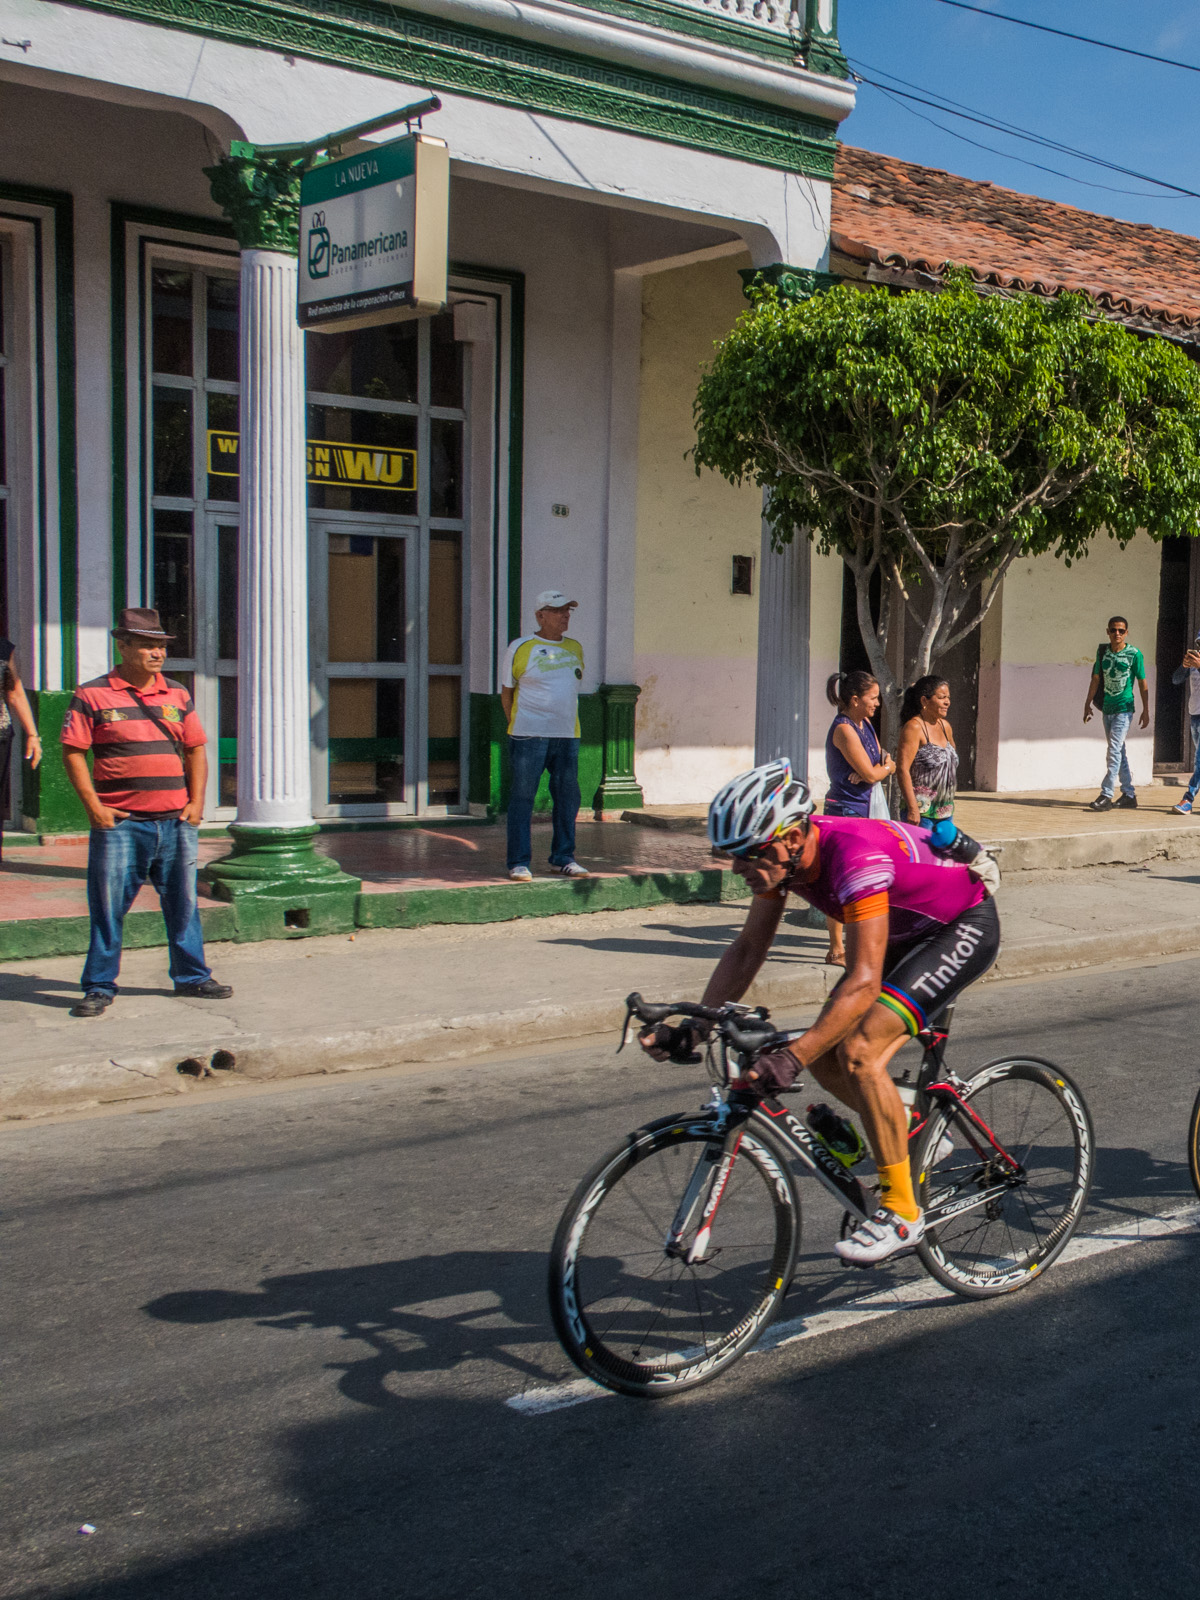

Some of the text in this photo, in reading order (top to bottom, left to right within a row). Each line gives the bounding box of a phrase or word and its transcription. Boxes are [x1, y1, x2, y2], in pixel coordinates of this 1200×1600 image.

[335, 160, 379, 187] LA NUEVA
[331, 230, 408, 265] Panamericana
[307, 306, 319, 317] Red
[318, 301, 343, 314] minorista
[343, 299, 351, 310] de
[351, 298, 356, 307] la
[343, 449, 403, 484] WU
[911, 922, 984, 998] Tinkoff
[1063, 1087, 1090, 1216] COSMIC
[928, 1244, 1028, 1288] COSMIC
[647, 1293, 776, 1385] COSMIC
